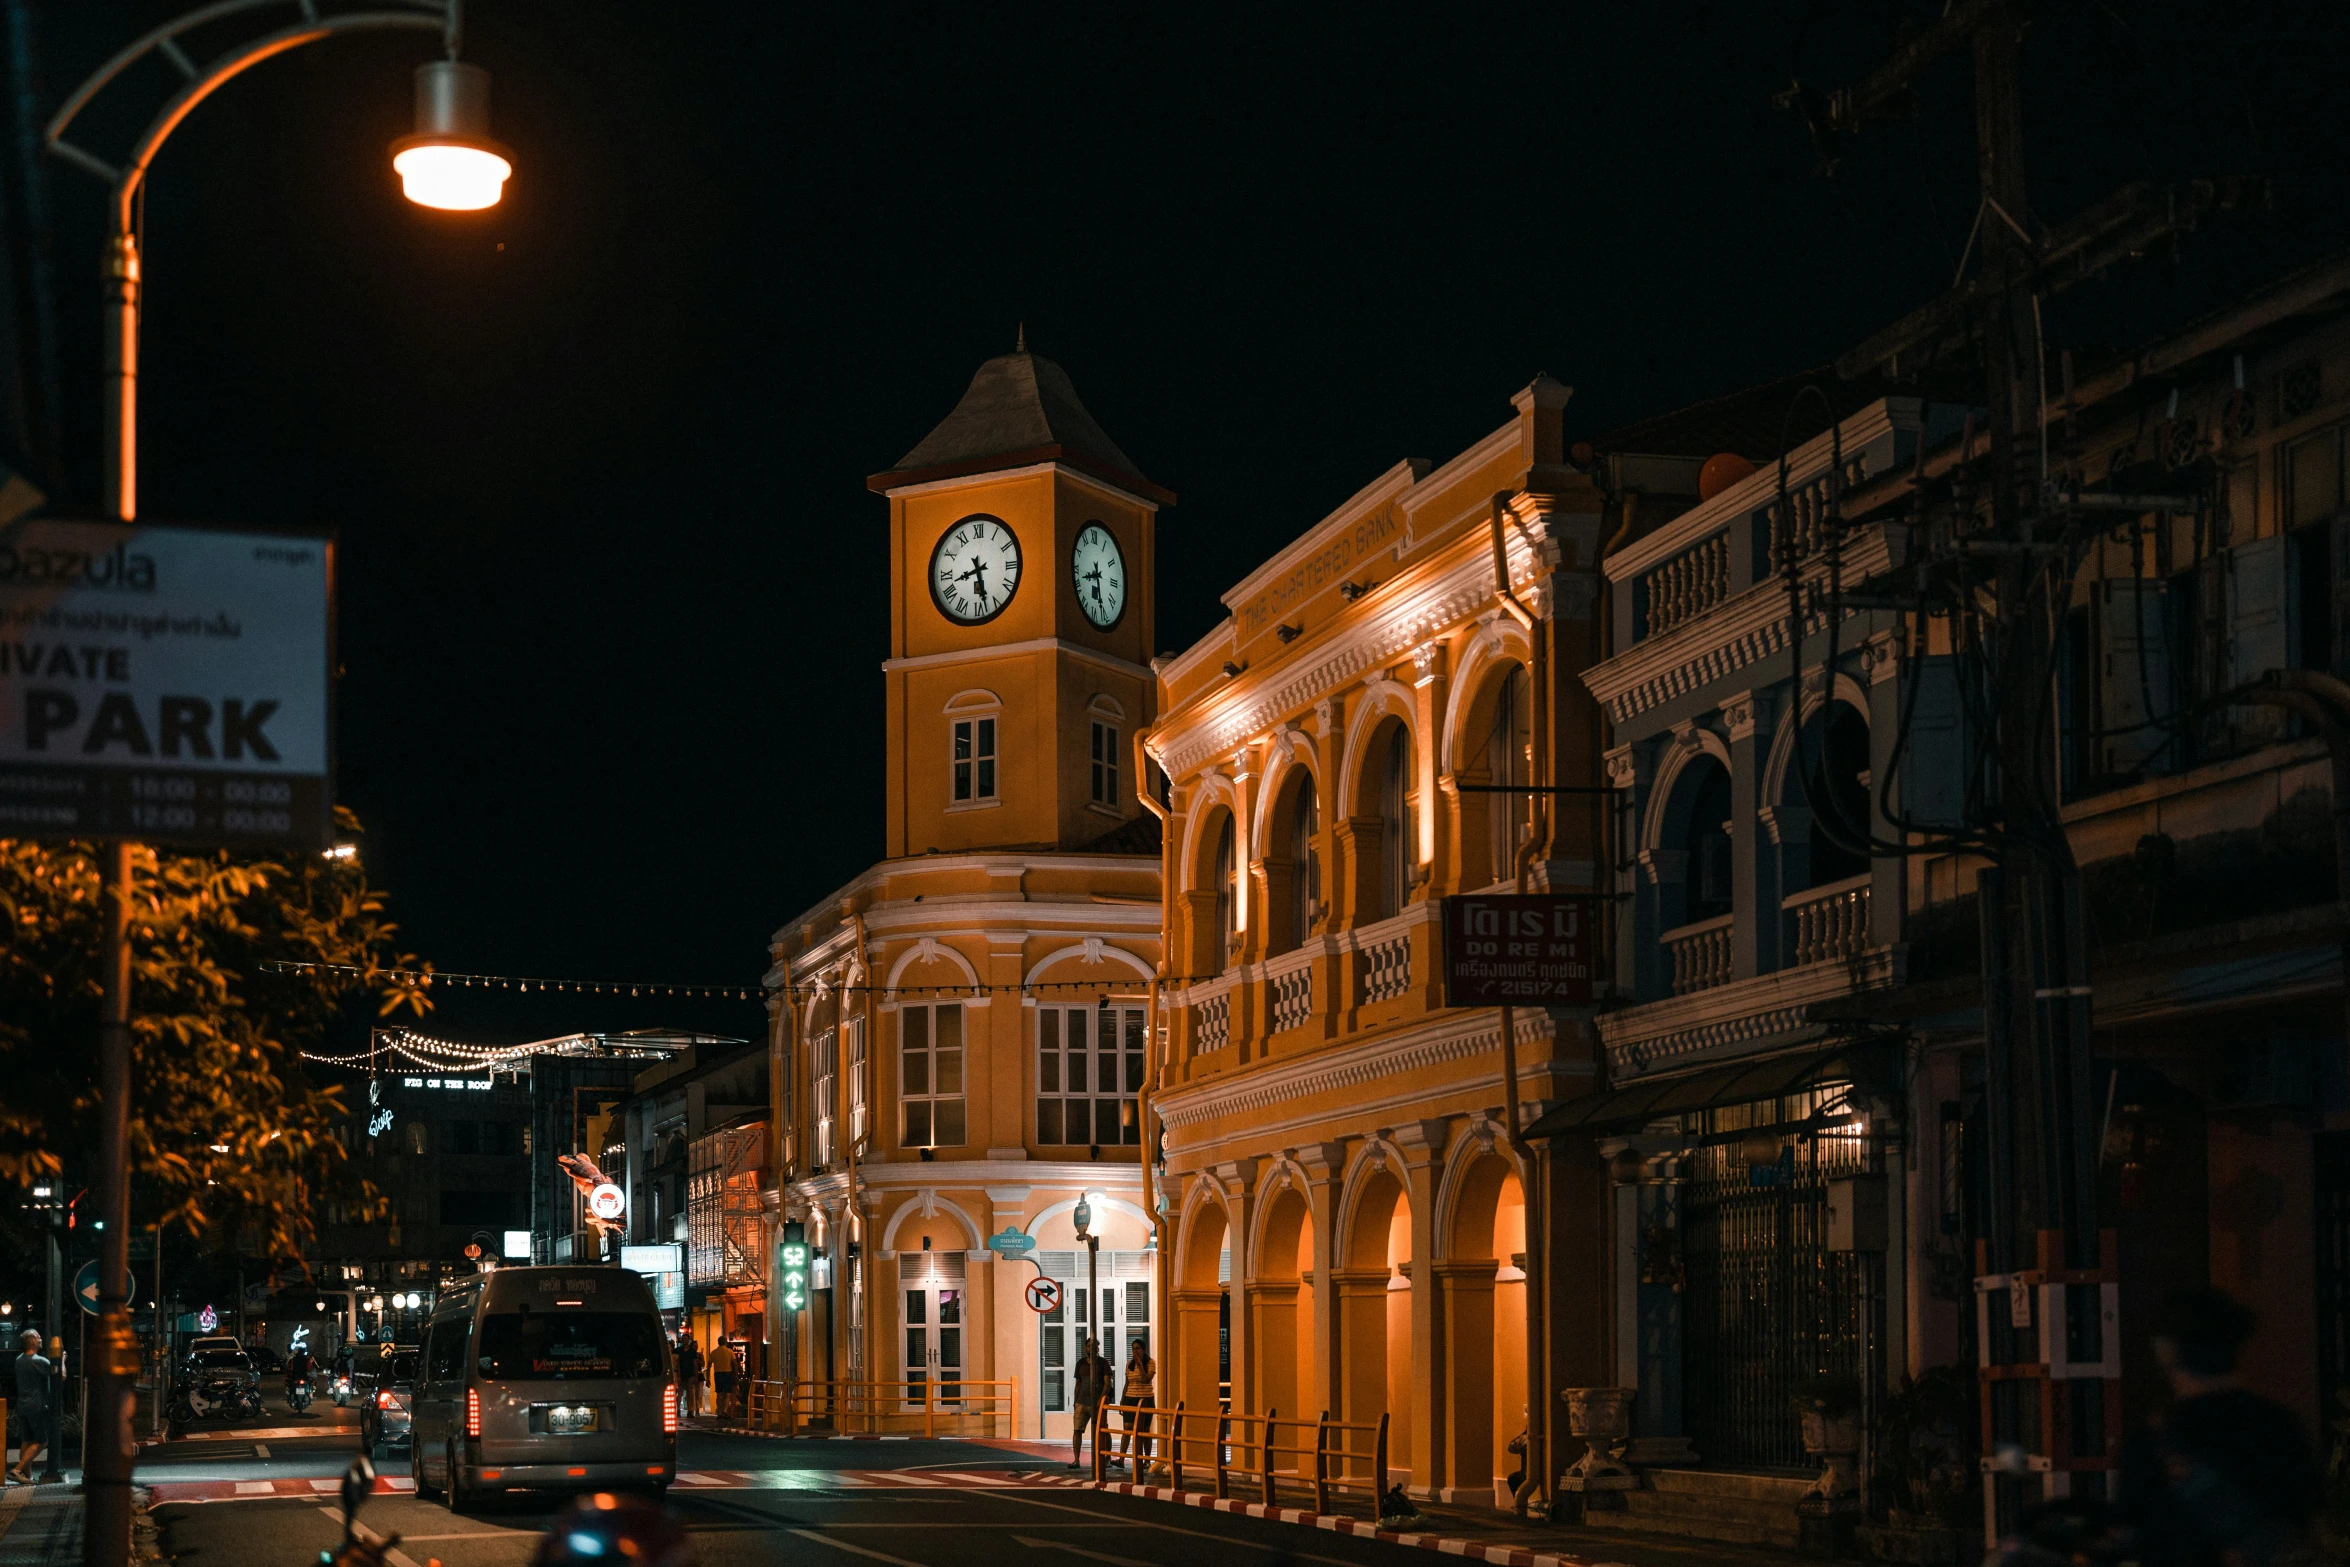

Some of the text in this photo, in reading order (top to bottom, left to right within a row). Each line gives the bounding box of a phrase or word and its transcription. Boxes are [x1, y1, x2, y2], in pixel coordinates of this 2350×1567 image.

[956, 530, 969, 547] XI
[973, 523, 984, 539] XII
[991, 526, 999, 541] I
[1001, 541, 1012, 552] II
[944, 549, 957, 561] X
[1005, 560, 1017, 570] III
[1245, 504, 1396, 634] THE CHARTERED BANK
[24, 688, 283, 763] PARK
[1466, 941, 1576, 958] DO RE MI
[427, 1078, 441, 1088] ON
[784, 1247, 804, 1265] 52
[551, 1412, 597, 1427] 30-9057
